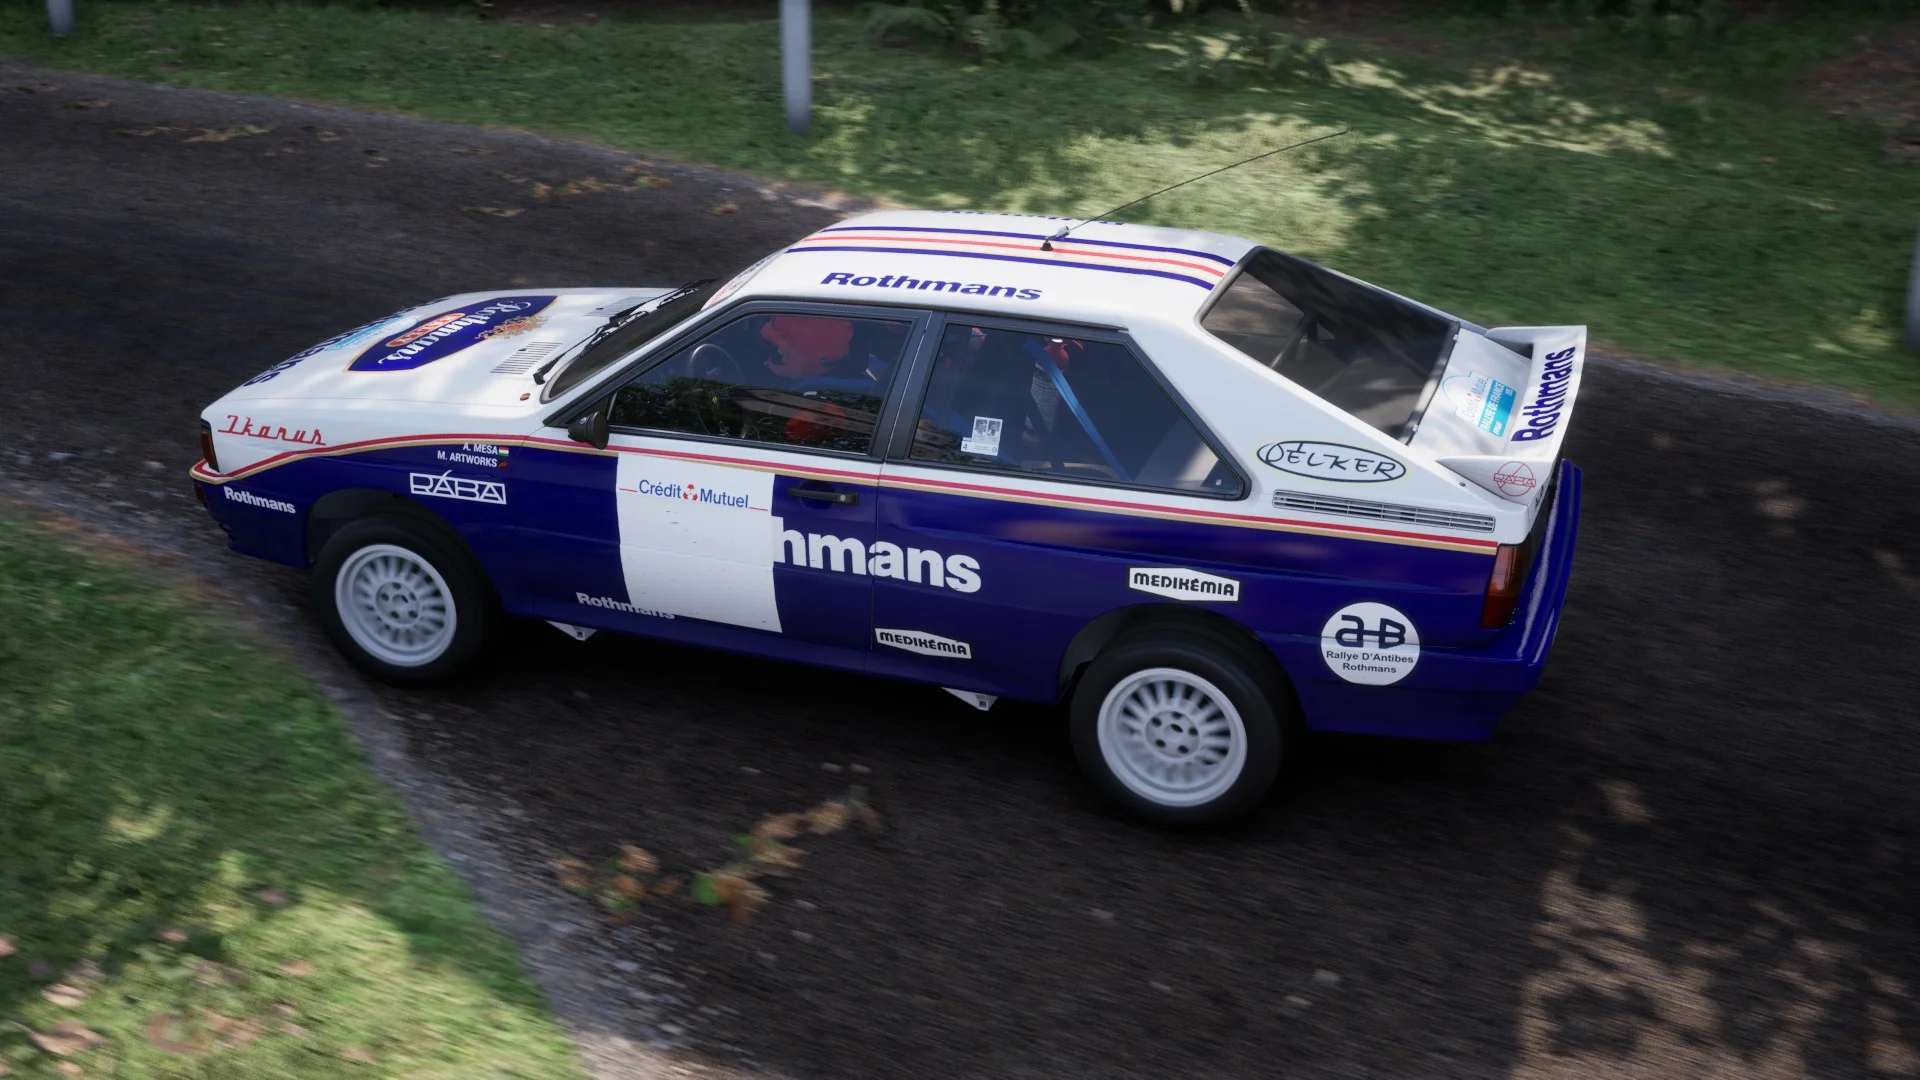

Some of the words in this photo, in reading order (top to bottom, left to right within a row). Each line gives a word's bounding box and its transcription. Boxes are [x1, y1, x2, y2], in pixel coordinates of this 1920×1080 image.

[820, 272, 1043, 300] Rothmans
[378, 300, 532, 364] Rothmans
[1511, 347, 1576, 442] Rothmans
[217, 415, 326, 446] Ikarus
[437, 450, 447, 460] M.
[449, 452, 497, 468] ARTWORKS
[463, 442, 471, 451] A.
[473, 443, 498, 455] MESA
[224, 487, 296, 514] Rothmans
[410, 469, 507, 504] RÁBA
[639, 479, 681, 499] Crédit
[700, 488, 749, 509] Mutuel
[773, 516, 982, 593] hmans
[1134, 572, 1234, 596] MEDIKÉMIA
[1326, 650, 1358, 662] Rallye
[1362, 652, 1414, 663] D'Antibes
[1342, 662, 1397, 674] Rothmans
